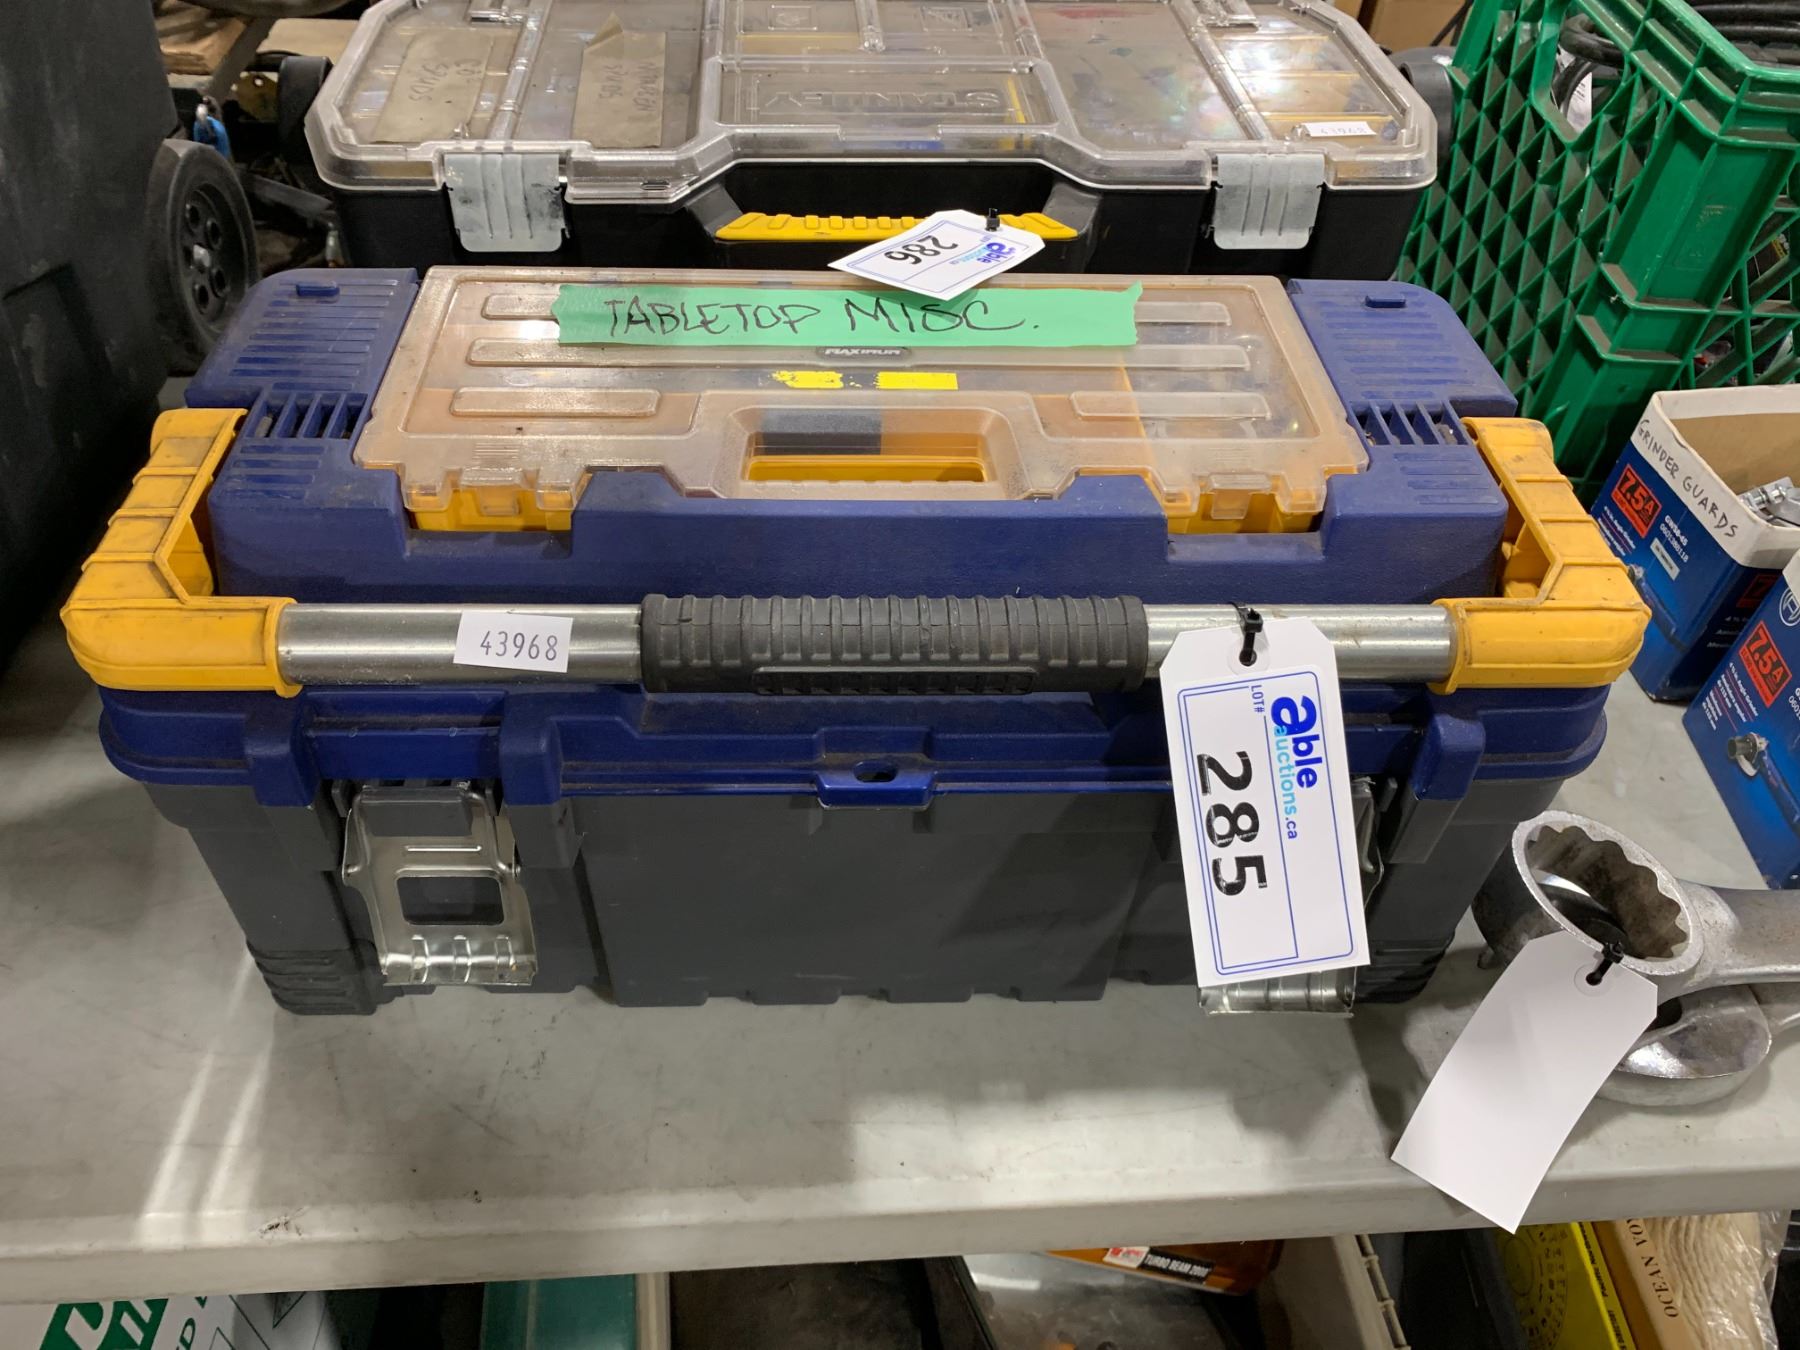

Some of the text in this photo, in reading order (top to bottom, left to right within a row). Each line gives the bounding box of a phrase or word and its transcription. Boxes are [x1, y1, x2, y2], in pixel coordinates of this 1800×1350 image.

[764, 91, 1001, 109] STANLEY
[884, 235, 958, 265] 286
[606, 295, 1040, 336] TABLETOP MISC.
[824, 347, 901, 357] MAXIMUM
[1638, 419, 1738, 538] GRINDER GUARDS
[480, 630, 558, 661] 43968
[1750, 627, 1784, 683] 7.5A
[1249, 684, 1265, 714] LOT#
[1270, 695, 1320, 789] able
[1274, 725, 1298, 840] auctions.ca
[1197, 751, 1268, 897] 285
[1641, 1255, 1680, 1318] OCEAN
